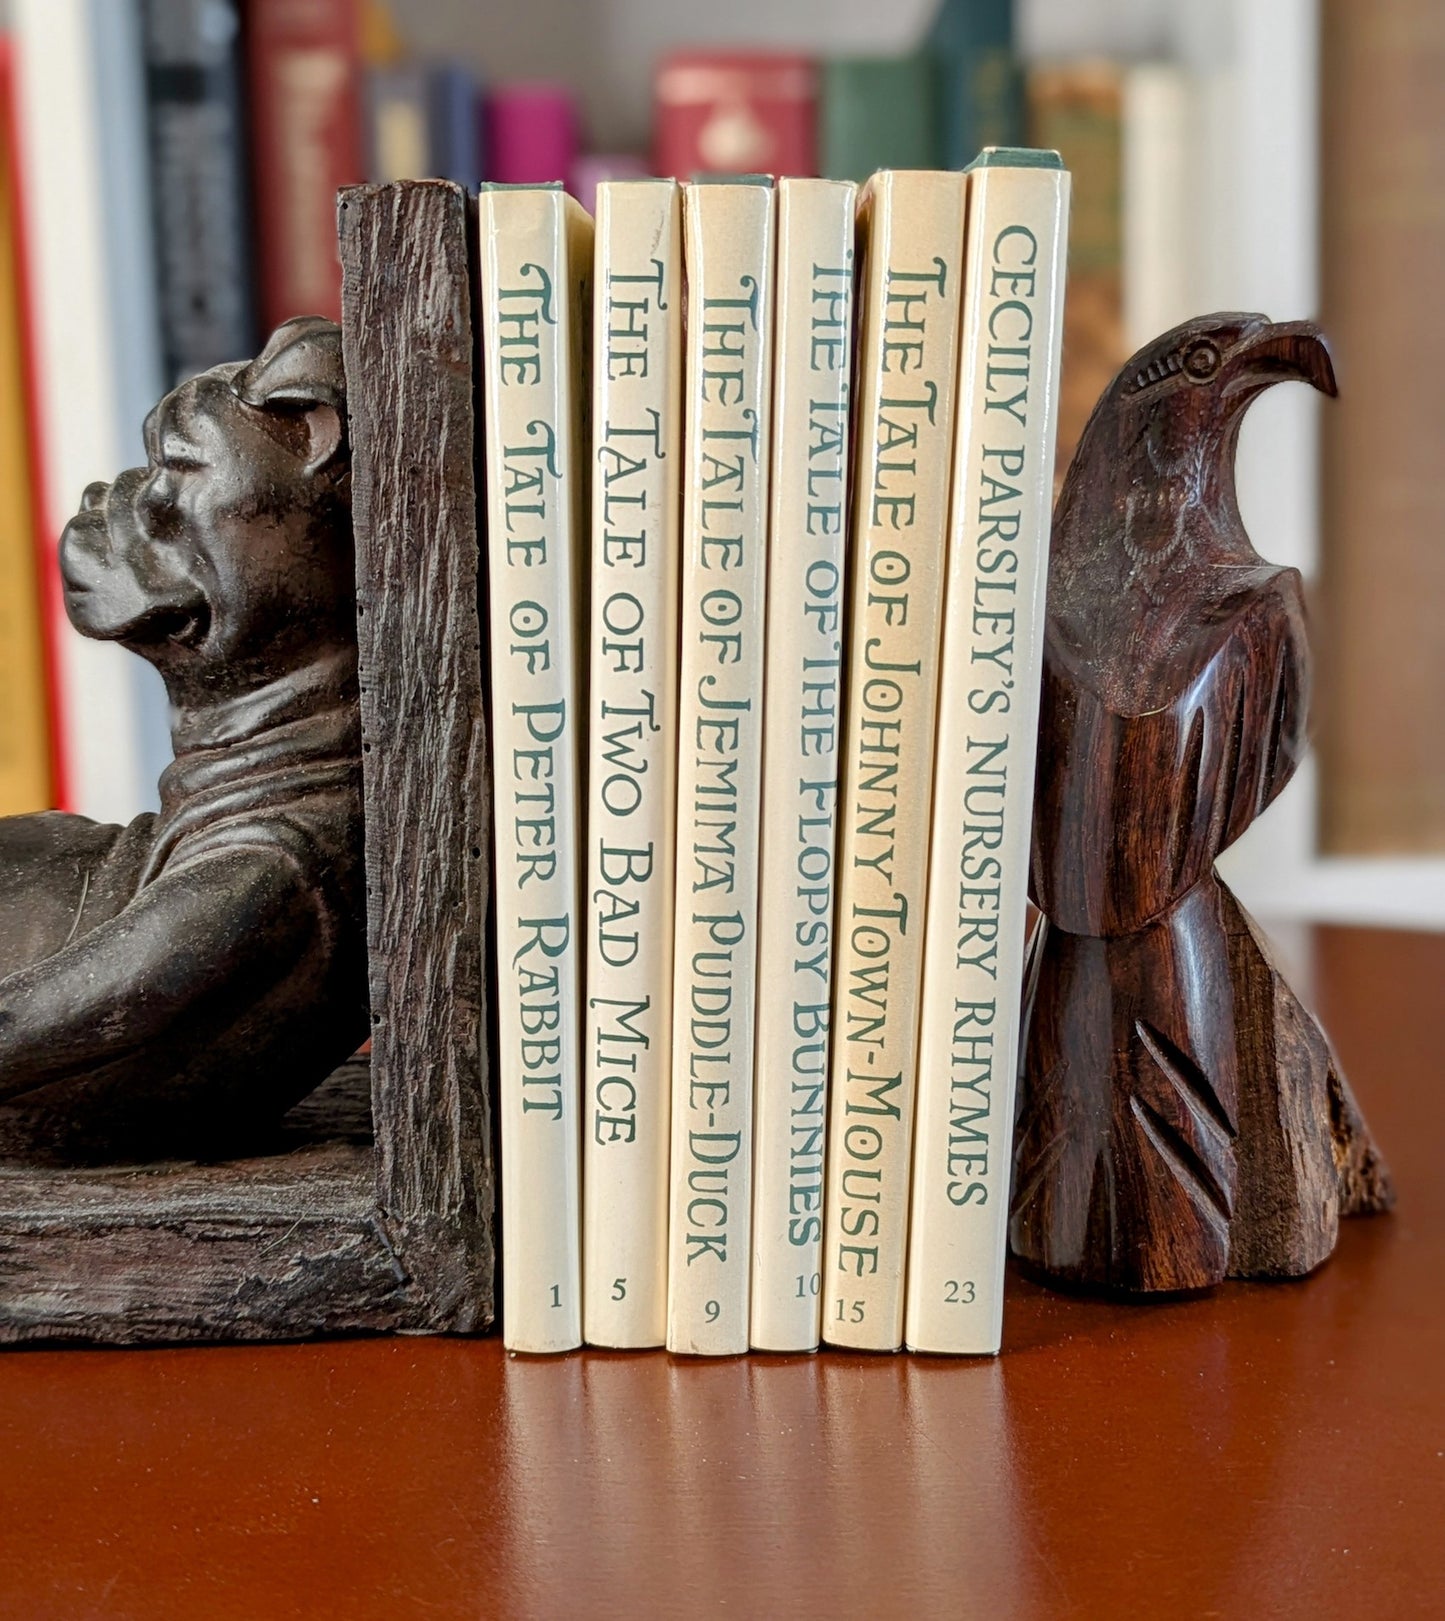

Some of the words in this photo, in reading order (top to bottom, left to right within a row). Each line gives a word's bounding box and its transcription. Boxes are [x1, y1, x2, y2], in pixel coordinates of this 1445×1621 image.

[499, 263, 558, 386] THE
[605, 259, 667, 381] THE
[701, 275, 758, 407] THE
[881, 257, 947, 375] THE
[984, 225, 1037, 428] CECILY
[504, 420, 563, 567] TALE
[598, 407, 665, 568] TALE
[701, 408, 758, 571] TALE
[872, 380, 937, 531] TALE
[509, 600, 550, 675] OF
[602, 592, 644, 673] OF
[700, 589, 742, 664] OF
[804, 560, 839, 635] OF
[867, 550, 911, 626] OF
[967, 444, 1026, 714] PARSLEY'S
[512, 698, 566, 889] PETER
[601, 689, 660, 816] TWO
[692, 675, 751, 893] JEMIMA
[854, 637, 921, 886] JOHNNY
[593, 838, 653, 967] BAD
[956, 734, 1009, 981] NURSERY
[512, 912, 570, 1121] RABBIT
[590, 995, 650, 1145] MICE
[686, 910, 745, 1267] PUDDLE-DUCK
[838, 892, 908, 1278] TOWN-MOUSE
[946, 997, 996, 1207] RHYMES
[550, 1284, 562, 1308] 1
[611, 1278, 627, 1301] 5
[705, 1300, 720, 1323] 9
[835, 1299, 865, 1323] 15
[943, 1280, 976, 1304] 23
